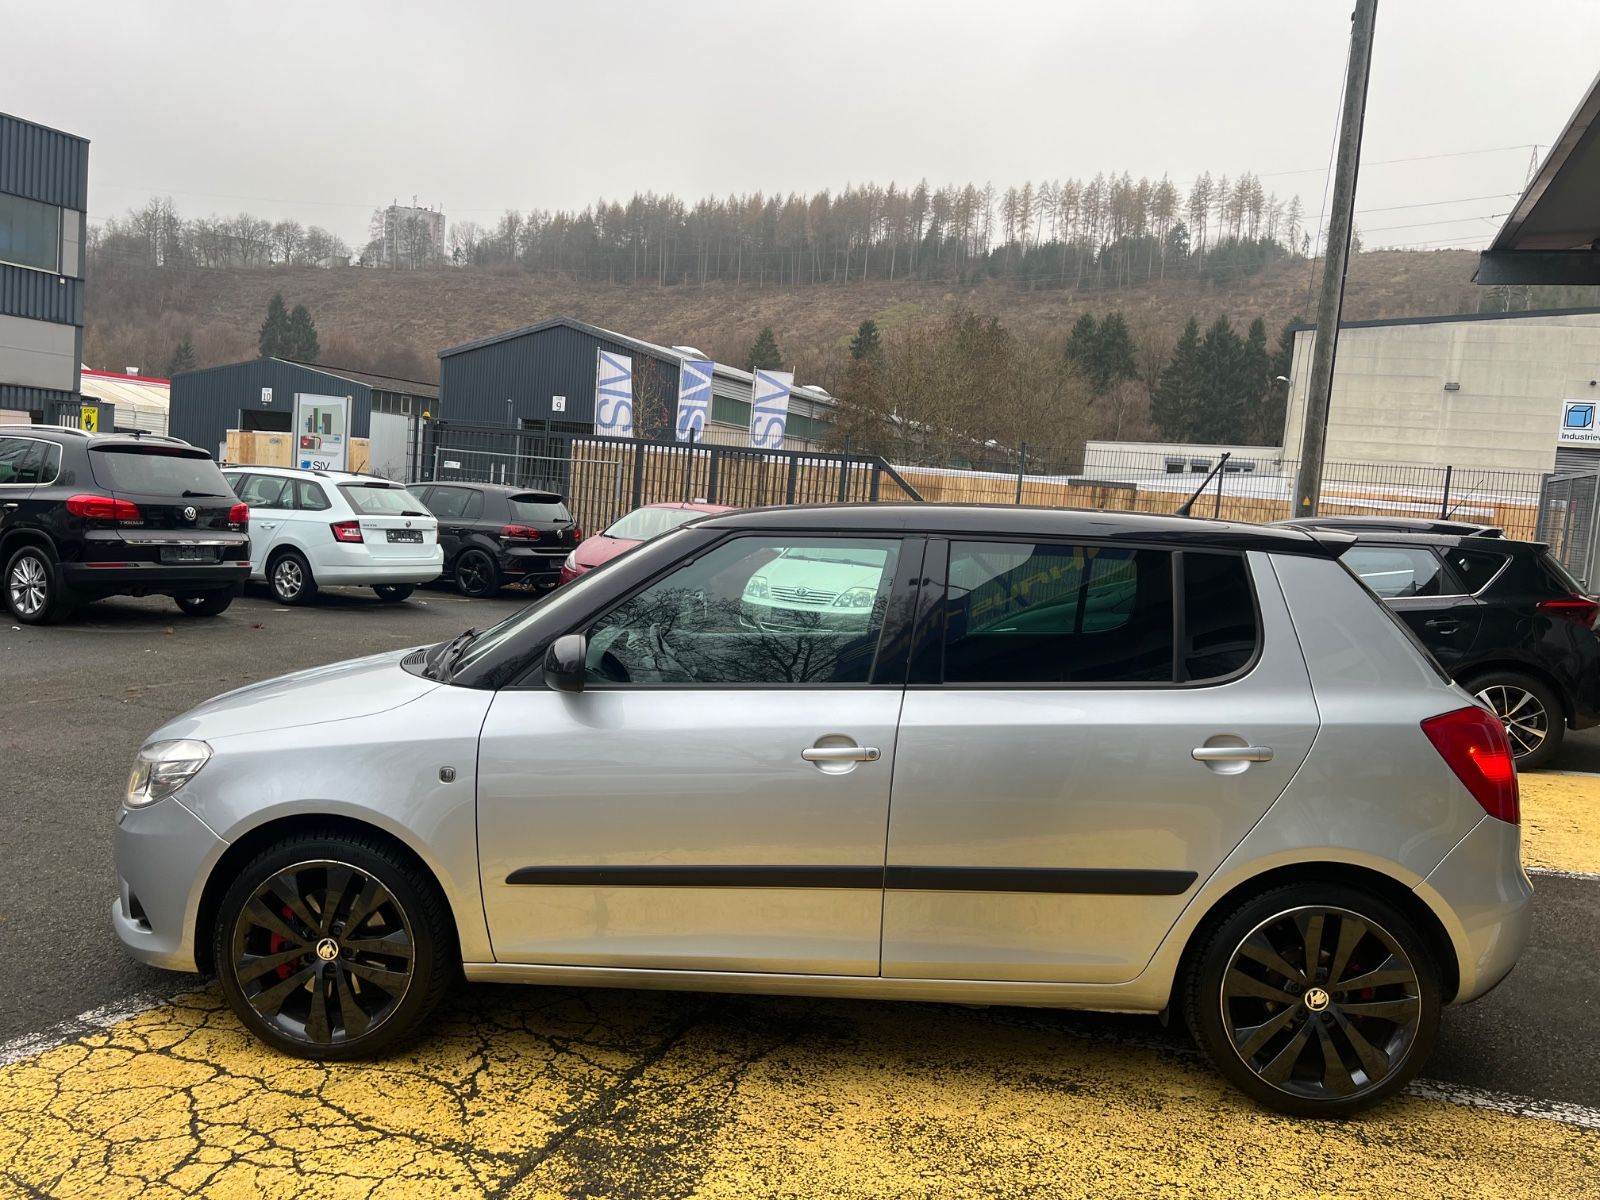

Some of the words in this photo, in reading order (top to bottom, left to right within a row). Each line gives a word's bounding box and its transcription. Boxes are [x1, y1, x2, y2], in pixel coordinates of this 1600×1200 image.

[263, 392, 271, 401] 10
[598, 352, 632, 432] SIV
[676, 362, 711, 444] SIV
[751, 370, 790, 450] SIV
[312, 459, 331, 470] SIV
